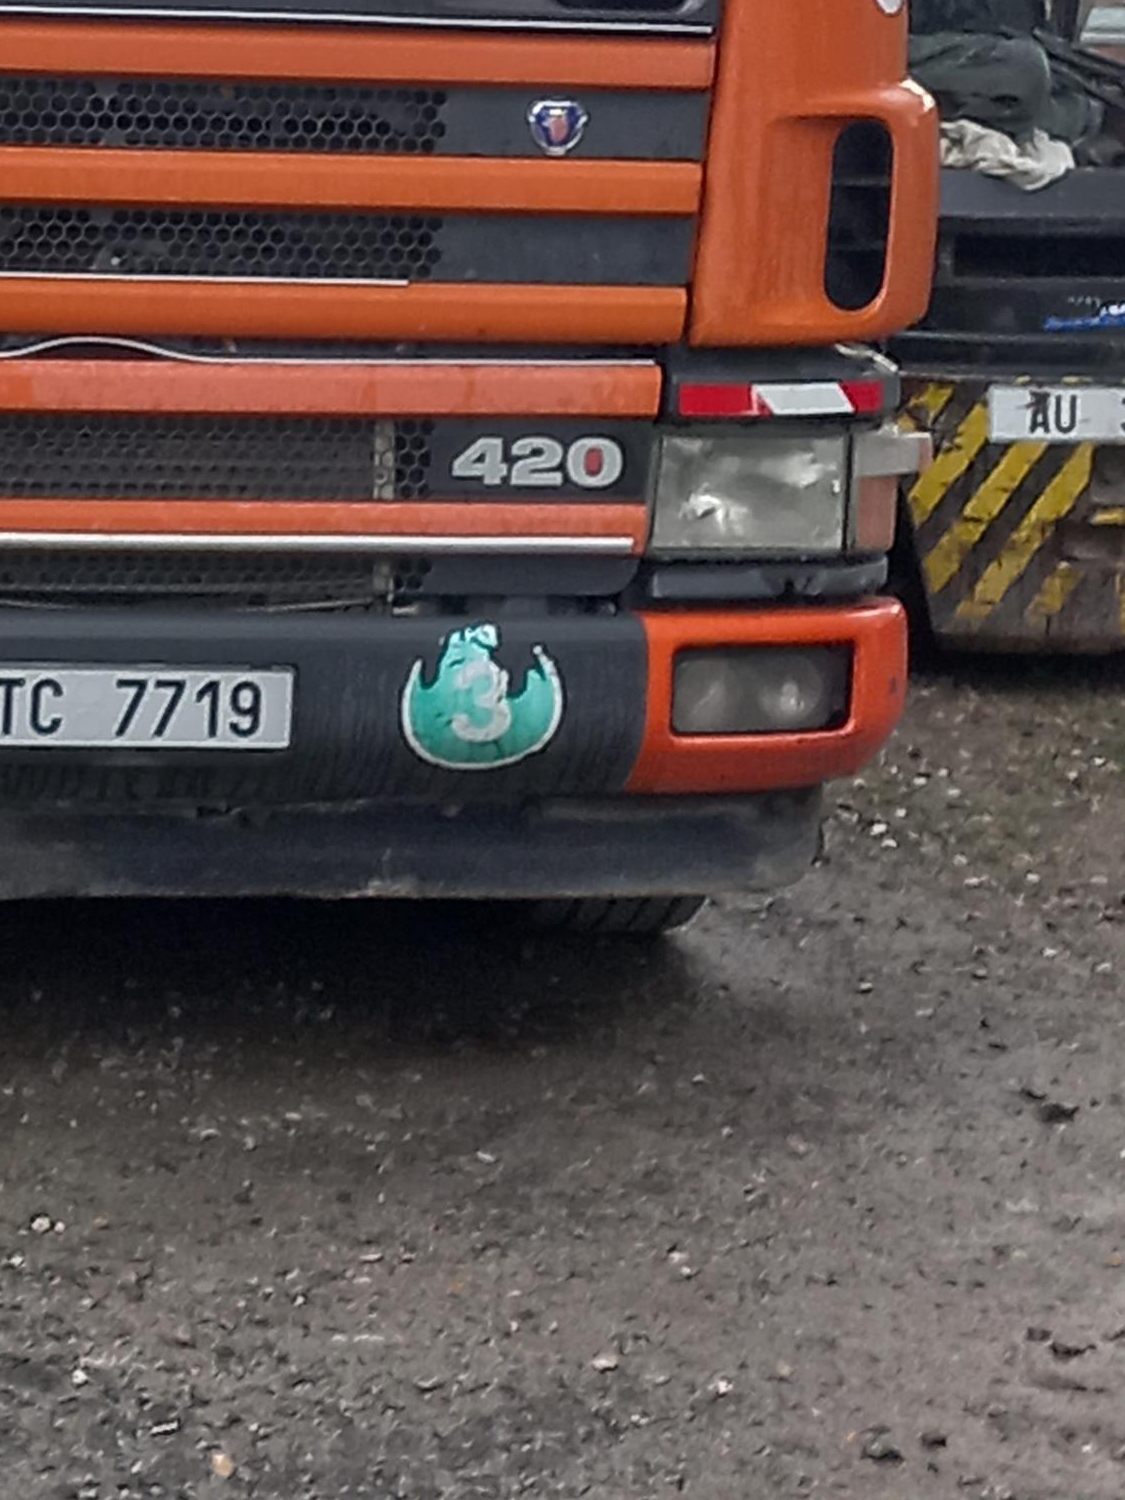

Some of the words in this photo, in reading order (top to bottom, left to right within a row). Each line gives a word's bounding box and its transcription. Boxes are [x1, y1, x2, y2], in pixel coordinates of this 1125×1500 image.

[1027, 392, 1078, 434] AU
[451, 436, 623, 489] 420
[115, 679, 263, 738] 7719
